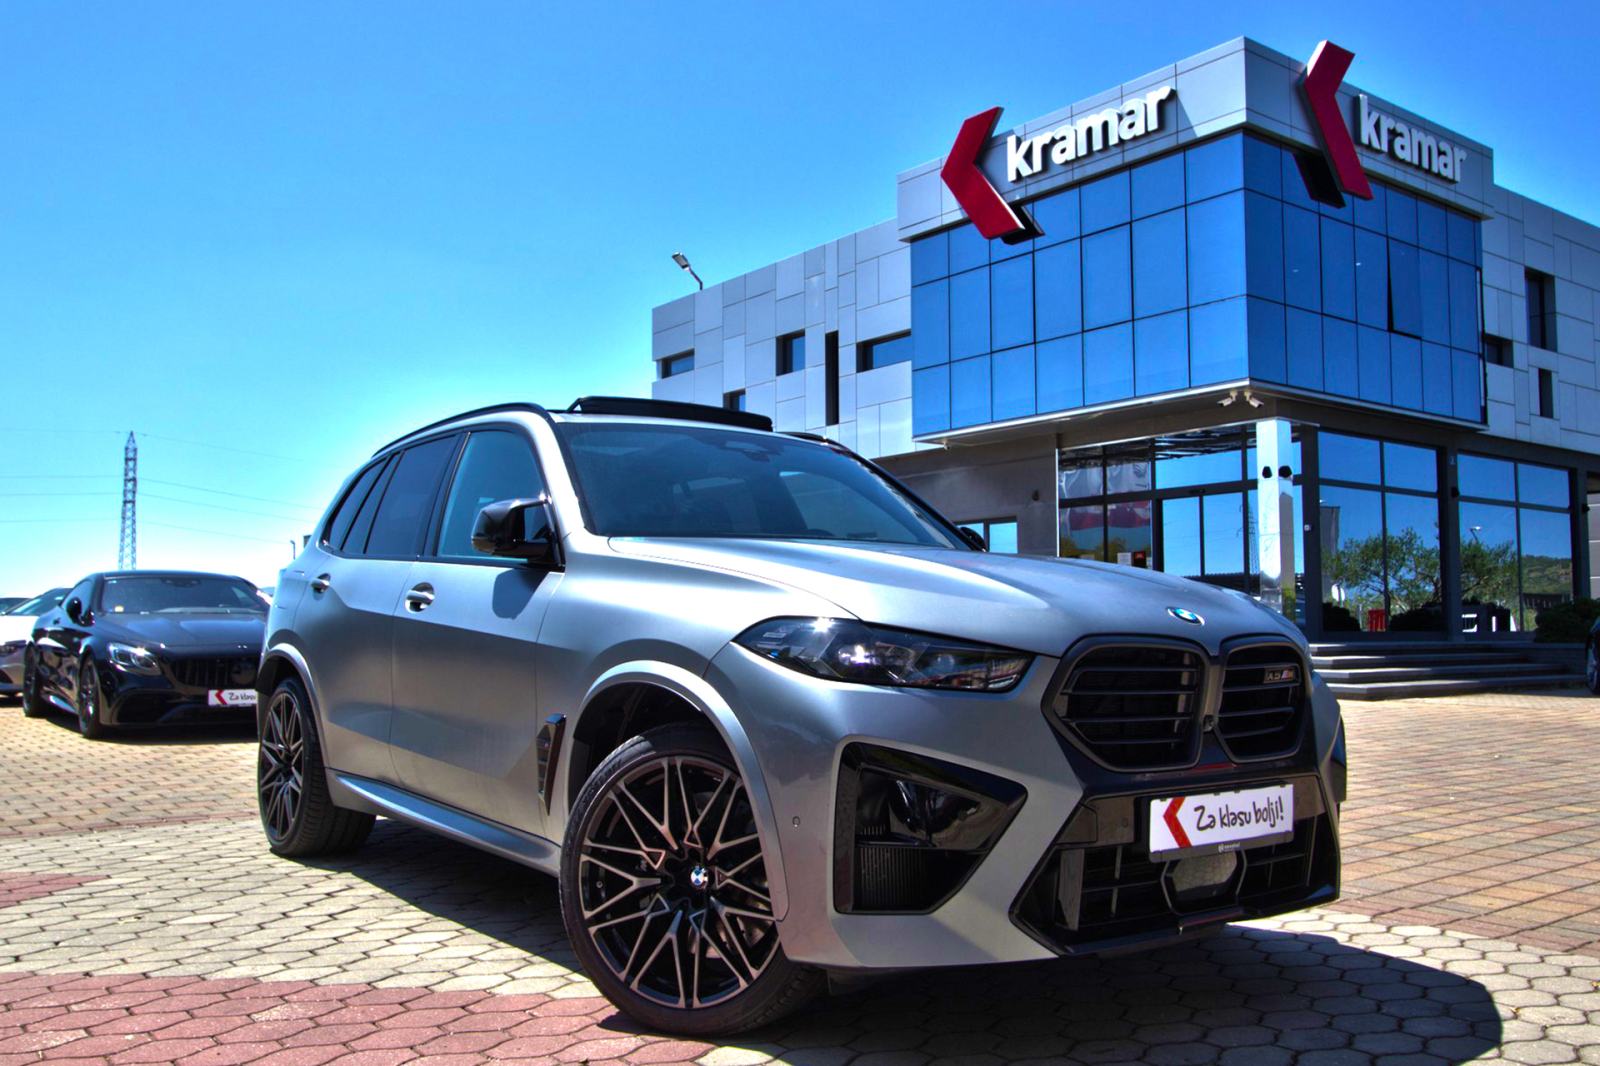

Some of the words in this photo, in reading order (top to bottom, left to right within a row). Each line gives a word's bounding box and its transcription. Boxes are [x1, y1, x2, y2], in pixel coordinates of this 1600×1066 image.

[1007, 86, 1171, 182] kramar
[1359, 94, 1467, 182] kramar
[1194, 805, 1216, 831] Za
[1219, 804, 1251, 829] klasu
[1253, 796, 1284, 828] bolji!
